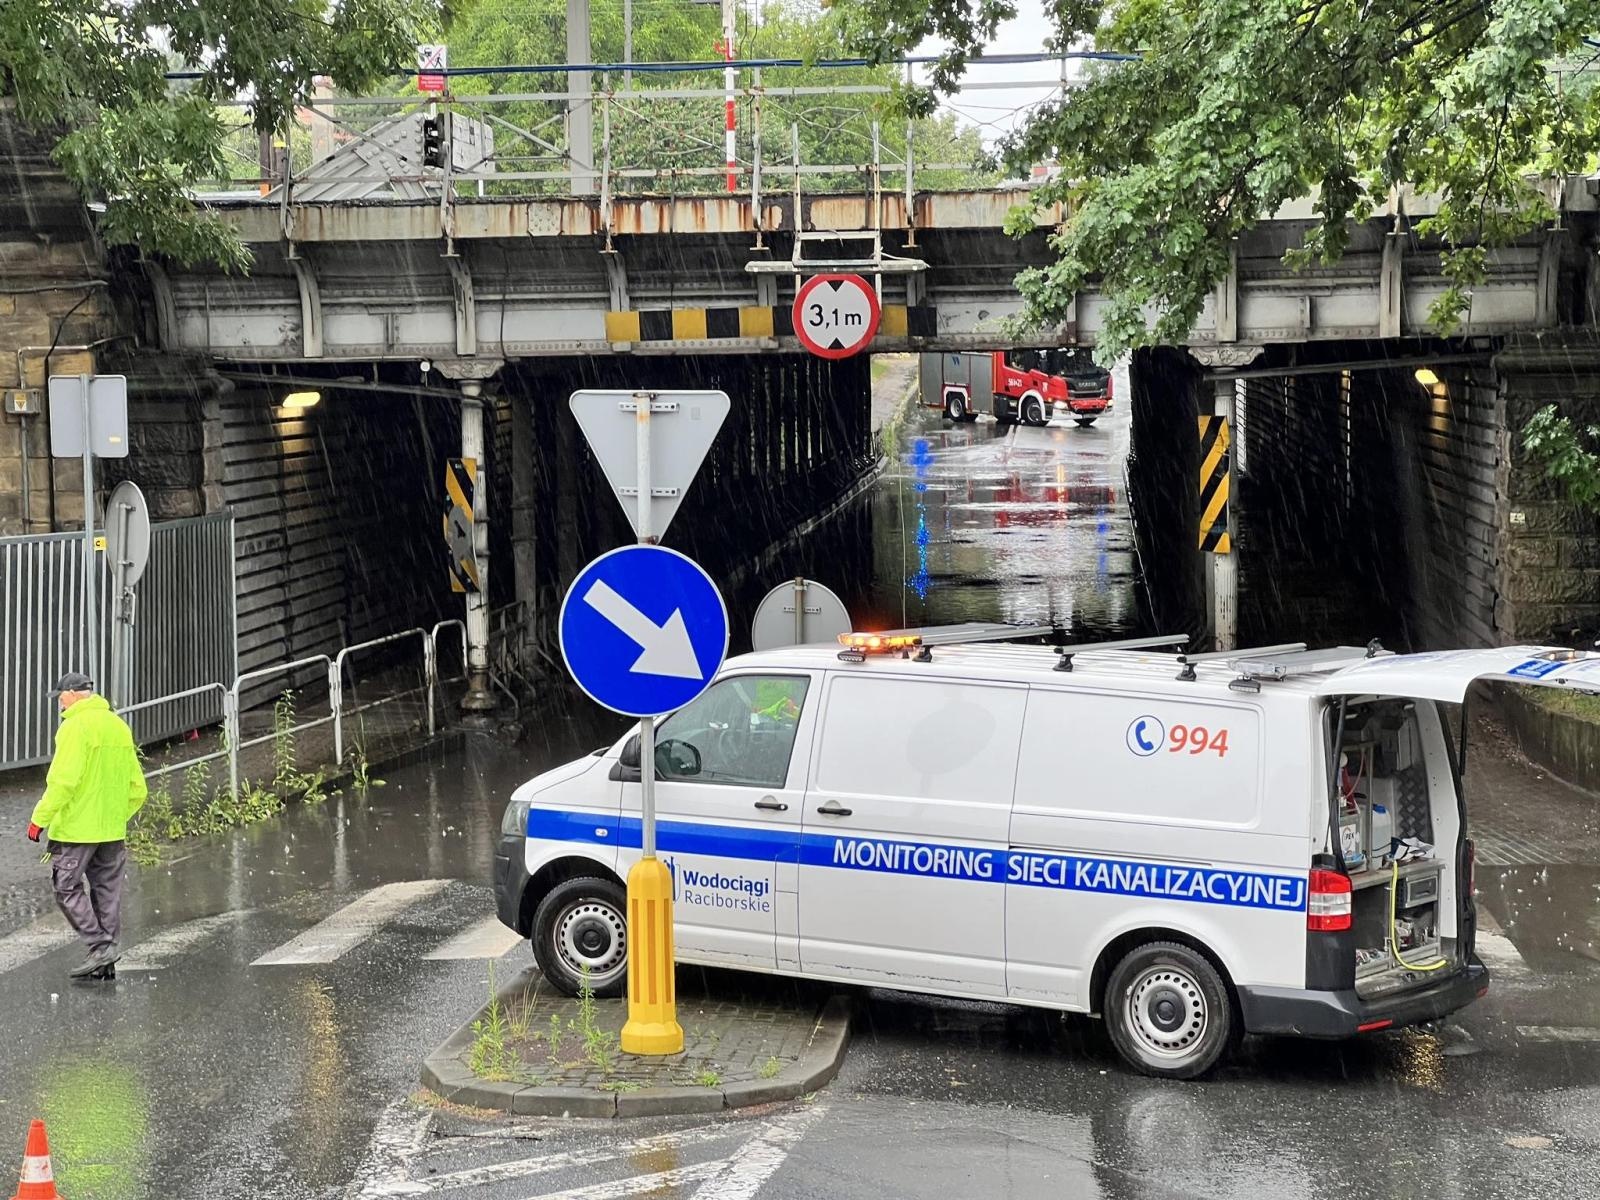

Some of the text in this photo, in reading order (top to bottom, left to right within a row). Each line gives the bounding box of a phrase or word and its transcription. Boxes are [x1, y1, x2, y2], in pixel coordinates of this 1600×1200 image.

[809, 303, 862, 330] 3,1 m
[1169, 724, 1229, 758] 994
[682, 869, 769, 897] Wodociągi
[833, 839, 1304, 908] MONITORING SIECI KANALIZACYJNEJ
[684, 889, 770, 913] Raciborskie
